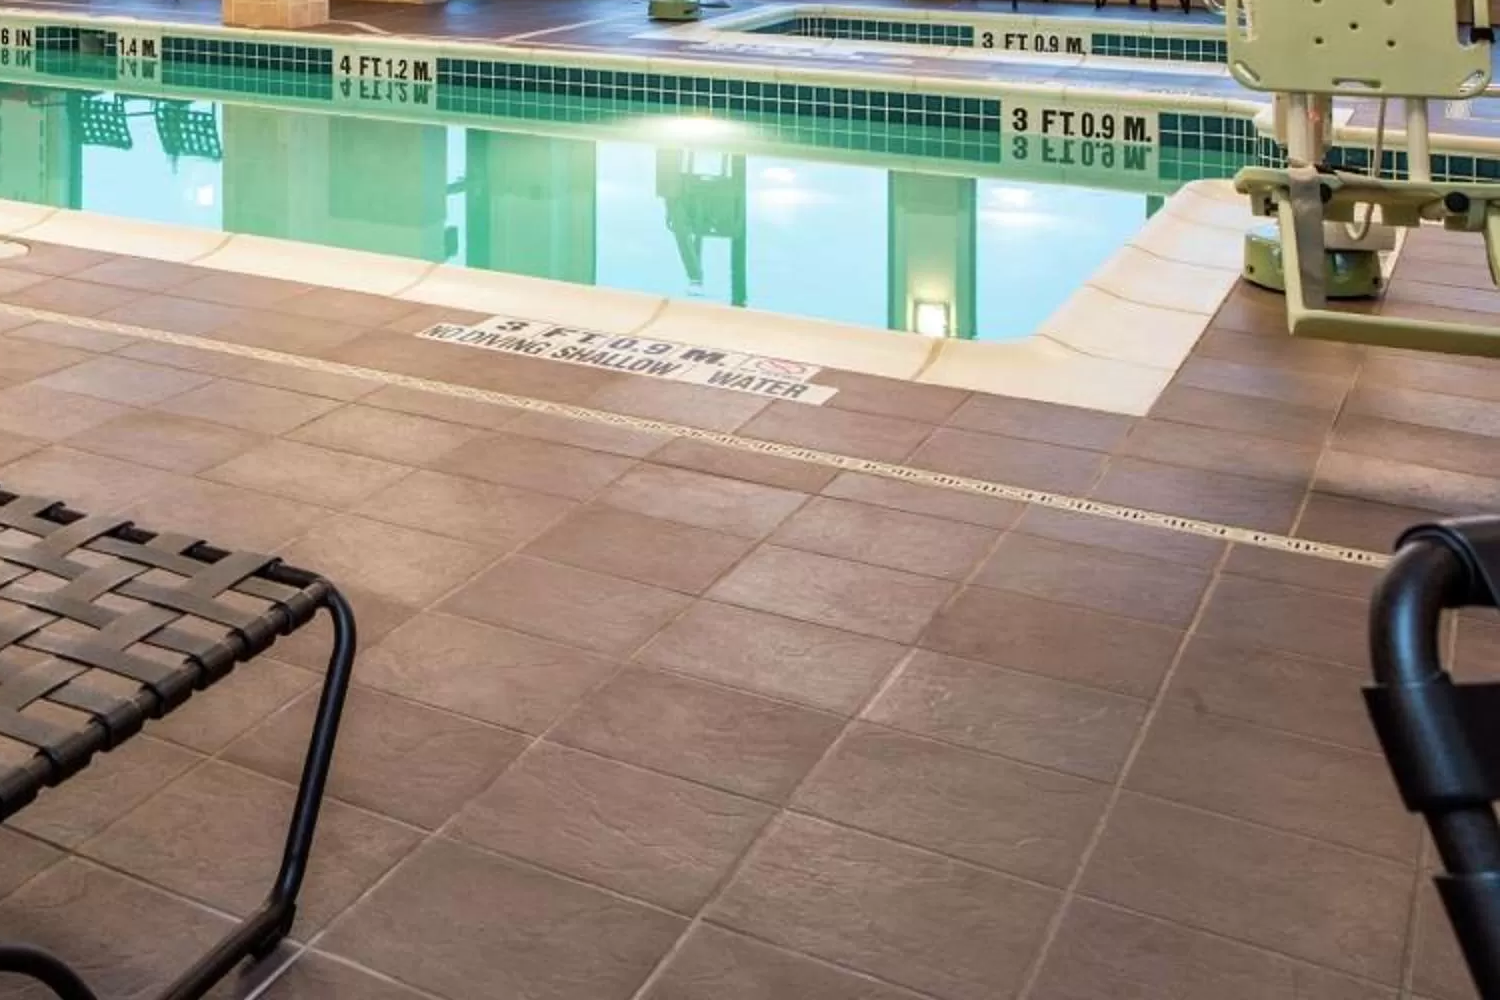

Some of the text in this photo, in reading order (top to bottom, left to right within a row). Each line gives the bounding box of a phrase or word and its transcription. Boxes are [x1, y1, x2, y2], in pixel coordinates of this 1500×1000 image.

[1, 28, 9, 45] 6
[982, 32, 994, 49] 3
[1035, 34, 1059, 53] 0.9
[339, 55, 351, 75] 4
[385, 58, 408, 80] 1.2
[1012, 107, 1029, 132] 3
[1081, 112, 1115, 139] 0.9
[1123, 116, 1152, 143] M.
[497, 321, 530, 332] 3
[608, 337, 674, 356] 0.9
[680, 348, 727, 367] M.
[426, 325, 462, 339] NO
[457, 329, 552, 355] DIVING
[551, 345, 683, 376] SHALLOW
[707, 370, 809, 399] WATER
